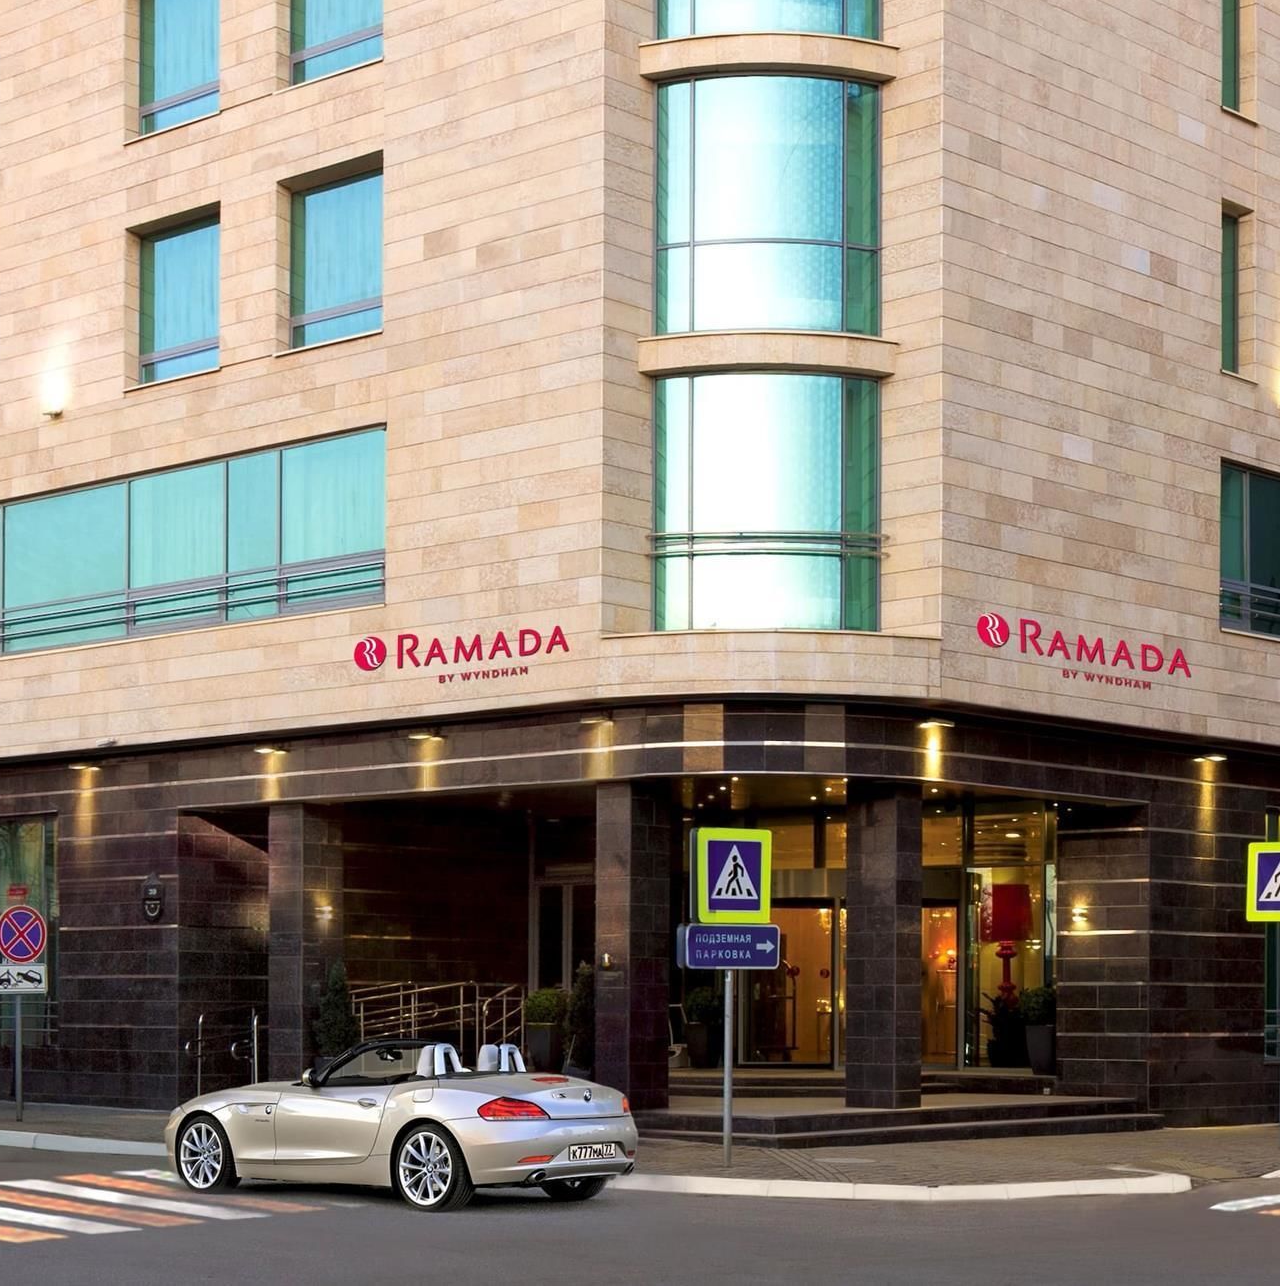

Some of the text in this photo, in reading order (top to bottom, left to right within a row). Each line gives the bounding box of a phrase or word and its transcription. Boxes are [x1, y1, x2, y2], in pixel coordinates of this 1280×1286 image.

[397, 625, 569, 668] RAMADA
[1019, 618, 1191, 677] RAMADA
[438, 666, 528, 683] BY WYNDHAM
[1063, 669, 1152, 690] BY WYNDHAM
[695, 934, 752, 943] ПОДЗЕМНАЯ
[695, 950, 752, 959] ПАРКОВКА
[605, 1144, 612, 1153] 77
